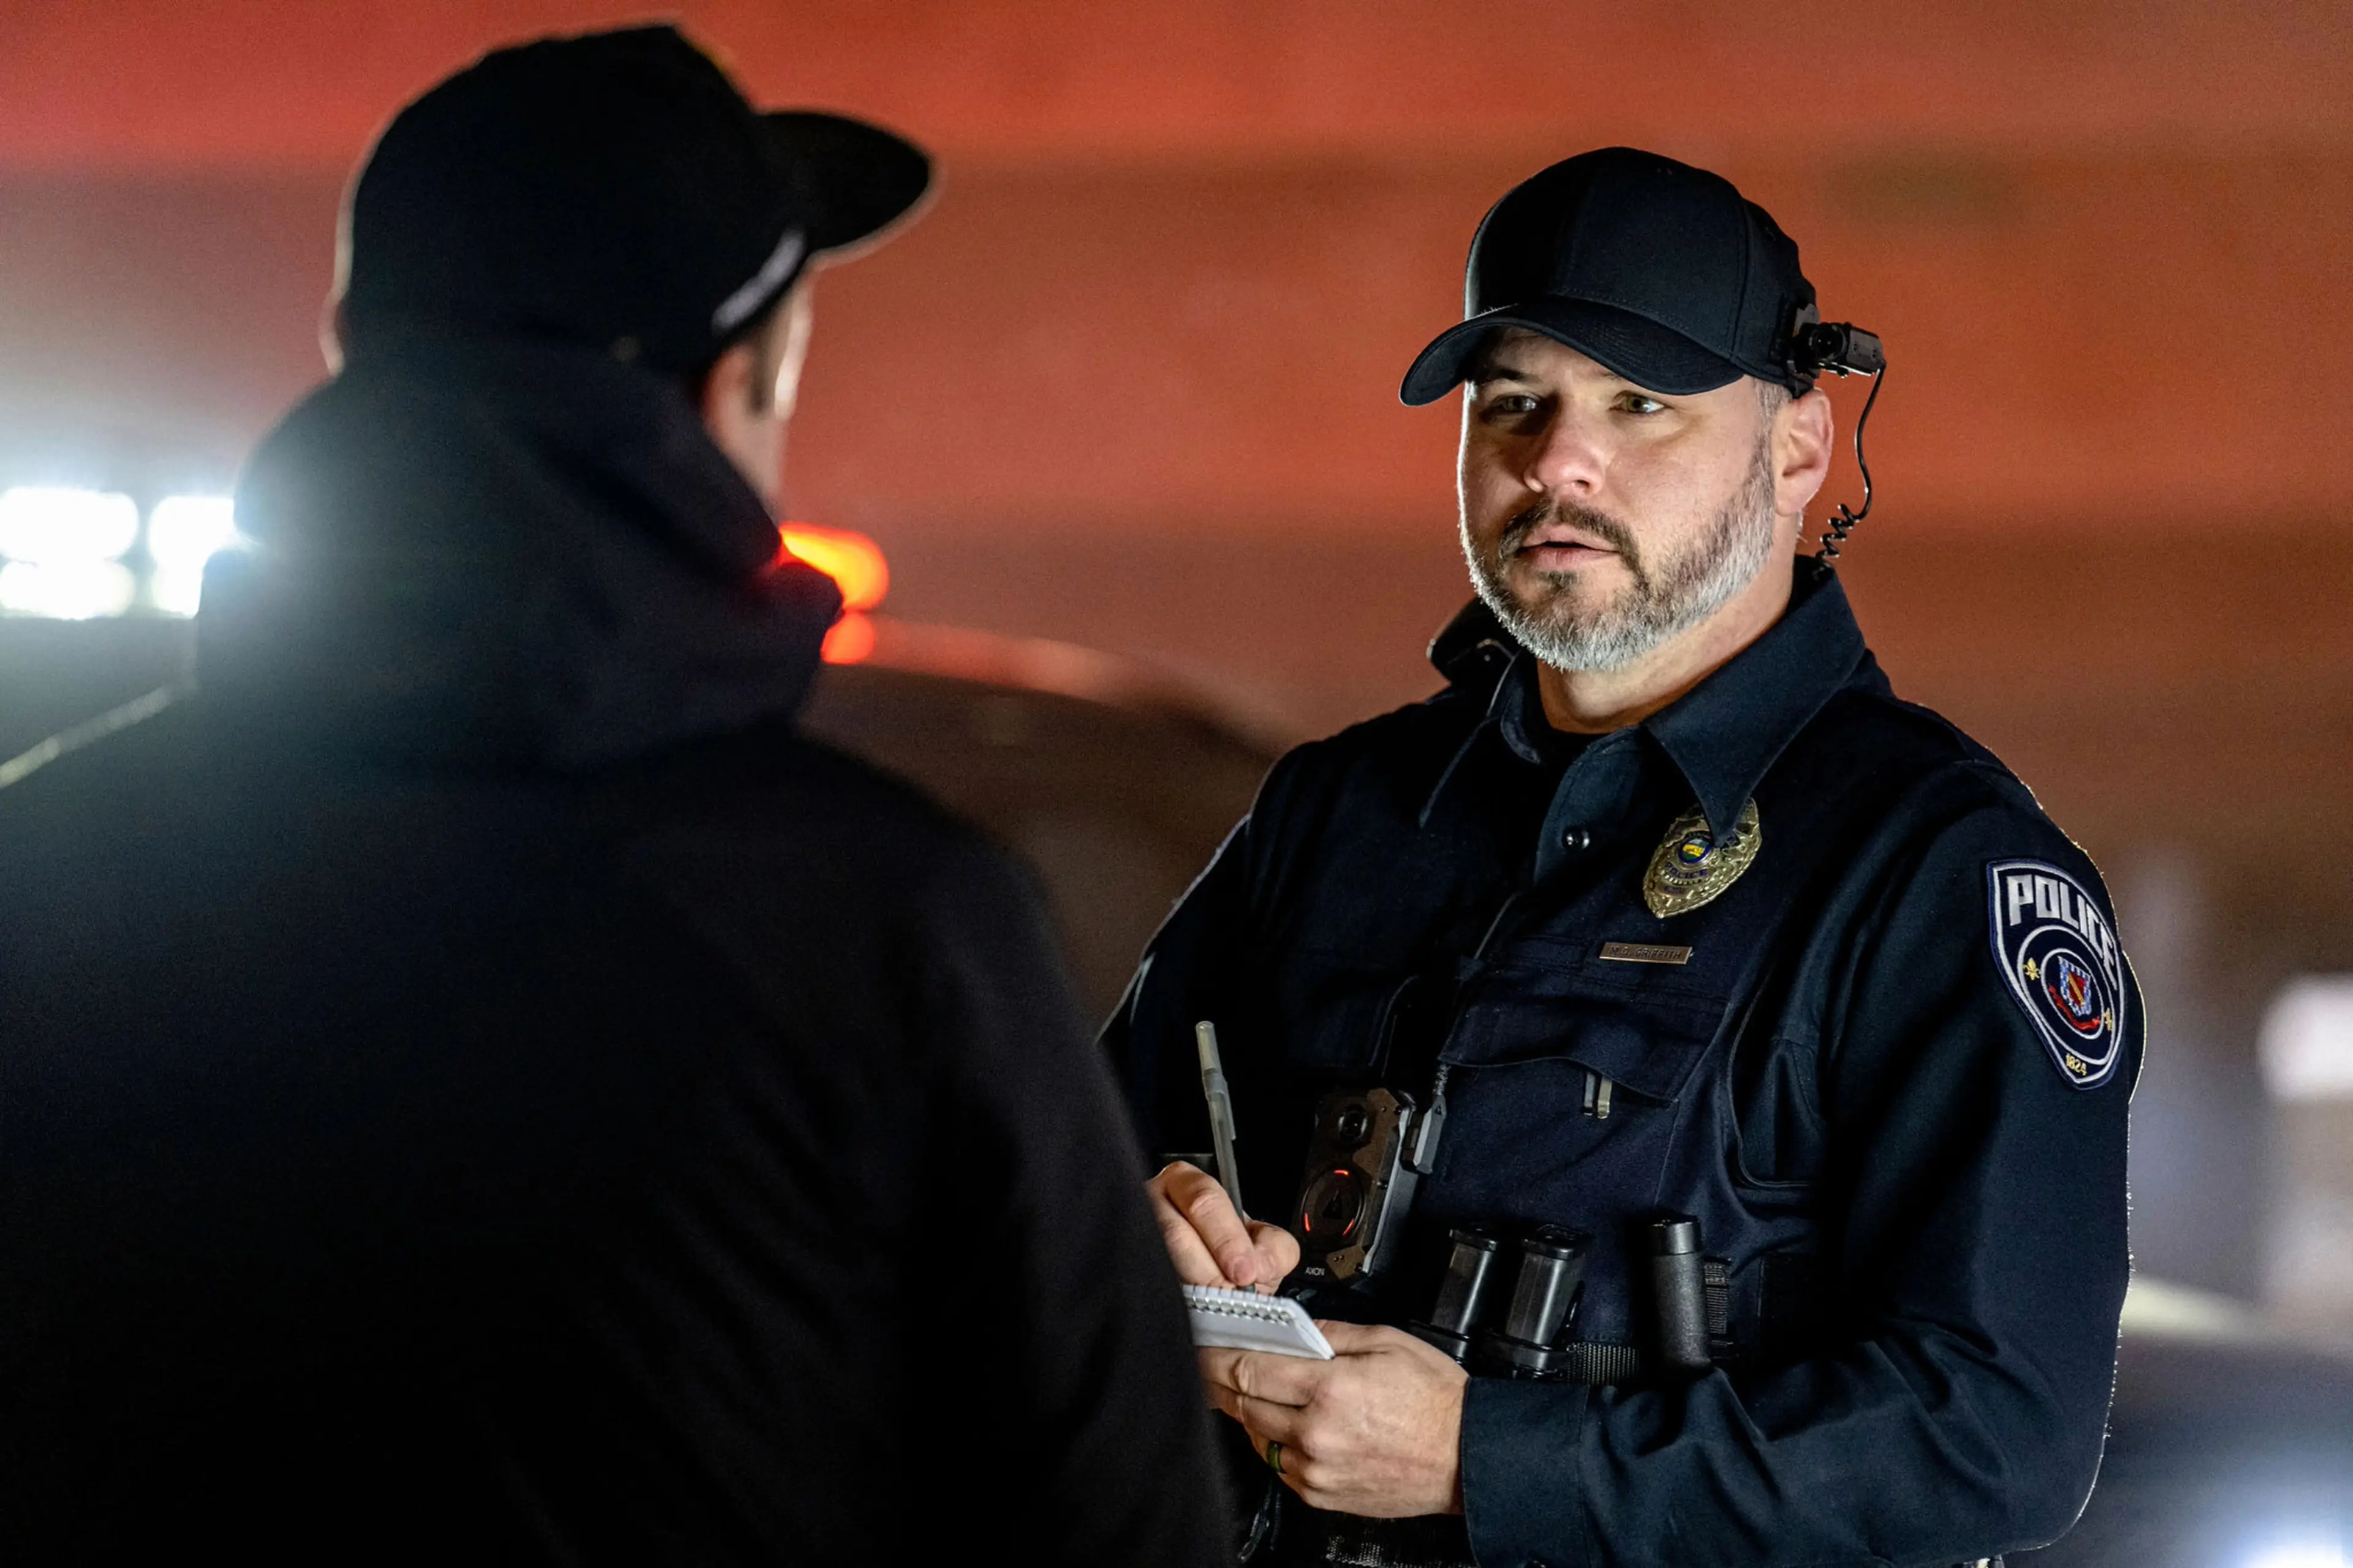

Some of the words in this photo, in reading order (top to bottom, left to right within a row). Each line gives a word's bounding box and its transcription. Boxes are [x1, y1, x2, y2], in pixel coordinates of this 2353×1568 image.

[2007, 874, 2118, 991] POLICE
[2066, 1053, 2087, 1075] 1824
[1305, 1267, 1325, 1276] AXON
